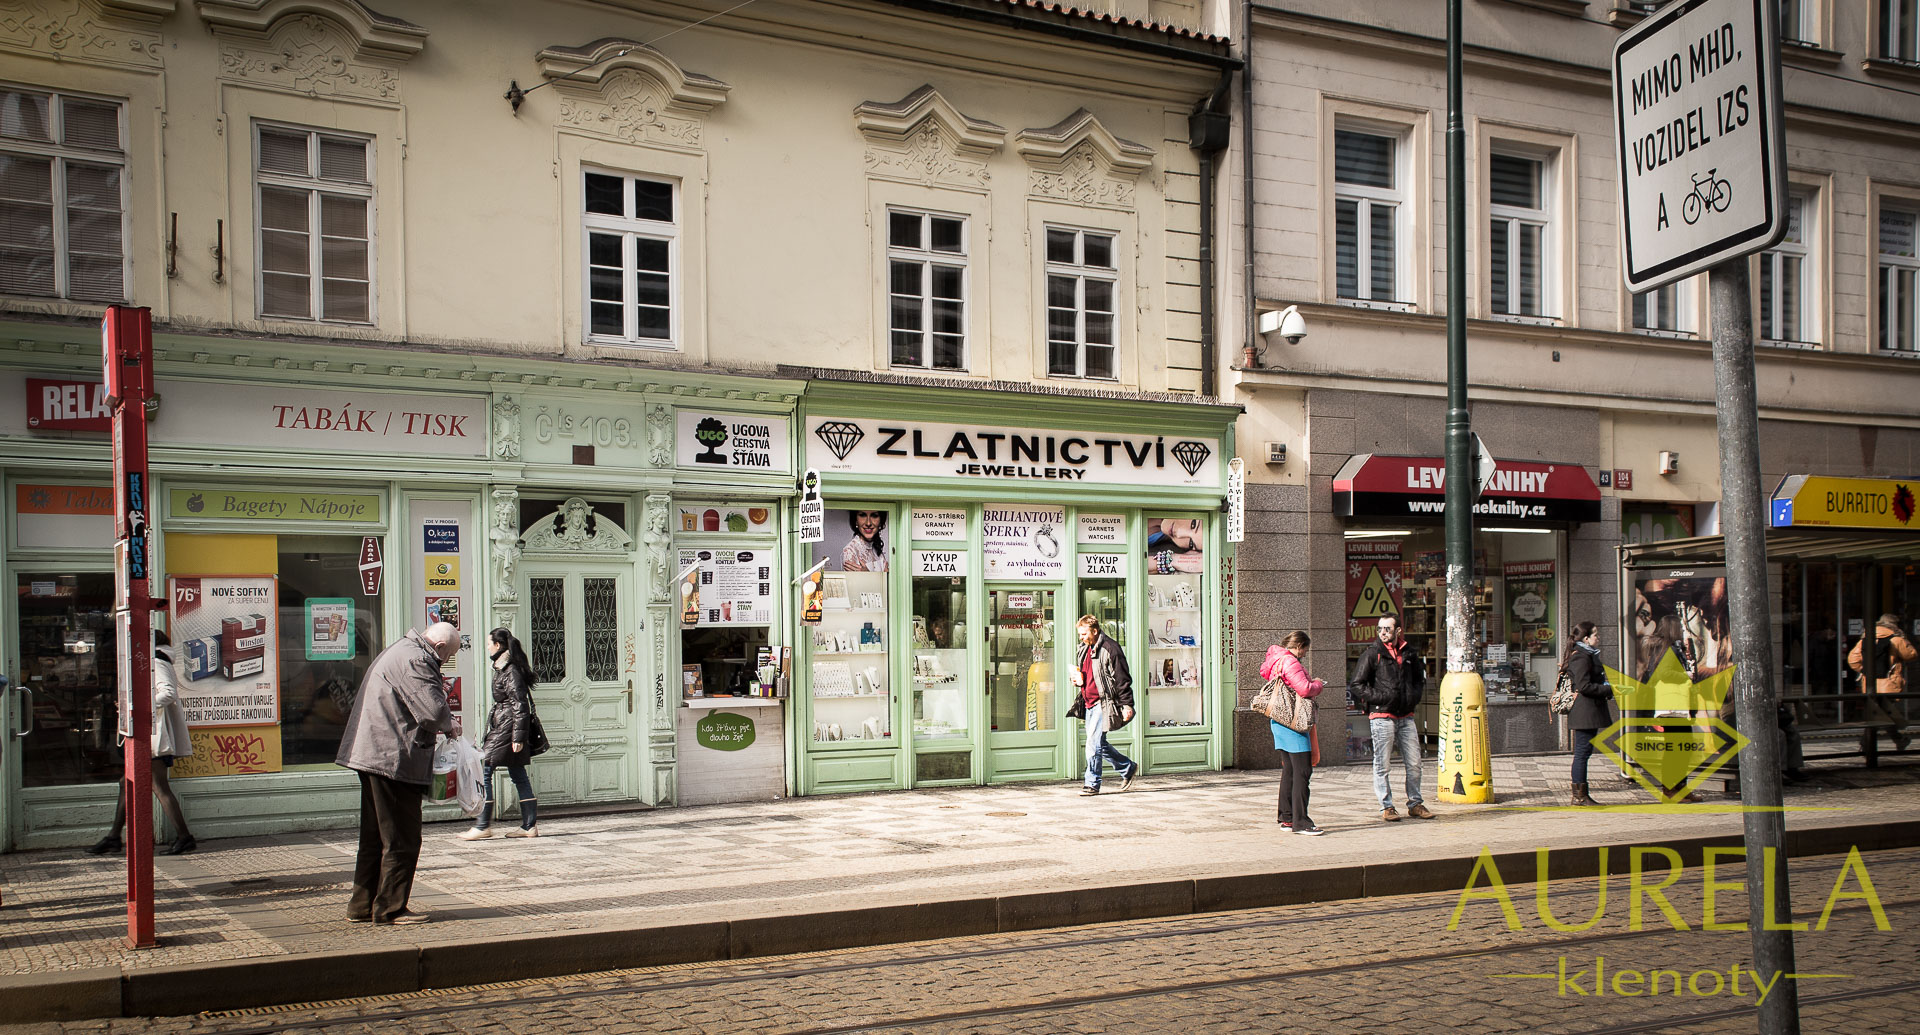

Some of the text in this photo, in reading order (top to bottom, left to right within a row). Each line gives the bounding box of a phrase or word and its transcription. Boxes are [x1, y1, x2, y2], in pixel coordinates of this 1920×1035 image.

[1632, 22, 1742, 116] MIMO MHD,
[1633, 84, 1749, 177] VOZIDEL IZS
[1657, 192, 1669, 232] A
[43, 384, 112, 420] RELA
[273, 403, 469, 437] TABÁK / TISK
[698, 430, 726, 441] UGO
[732, 424, 770, 437] UGOVA
[732, 436, 770, 449] ČERSTVÁ
[876, 428, 1165, 468] ZLATNICTVÍ
[732, 449, 771, 467] ŠŤÁVA
[956, 463, 1086, 480] JEWELLERY
[1408, 466, 1446, 489] LEV
[1618, 472, 1629, 481] 104
[1601, 474, 1609, 483] 43
[62, 489, 114, 509] Tabá
[1826, 491, 1888, 514] BURRITO
[222, 495, 365, 519] Bagety Nápoje
[801, 502, 821, 514] UGOVA
[1408, 500, 1546, 518] wwwneknihy.cz
[938, 511, 965, 520] STŘÍBRO
[984, 510, 1063, 523] BRILIANTOVÉ
[437, 529, 456, 537] karta
[984, 523, 1030, 537] ŠPERKY
[1348, 543, 1399, 552] LEVNÉ KNIHY
[922, 551, 958, 562] VÝKUP
[1086, 554, 1119, 565] VÝKUP
[923, 563, 957, 572] ZLATA
[1047, 561, 1063, 570] ceny
[1087, 565, 1117, 574] ZLATA
[1506, 563, 1552, 573] LEVNÉ KNIHY
[1024, 568, 1047, 577] od nás
[176, 587, 195, 602] 76
[211, 585, 269, 597] NOVÉ SOFTKY
[1351, 624, 1377, 641] výpr
[240, 638, 264, 648] Winston
[209, 645, 217, 668] Winston
[181, 696, 213, 708] NISTERSTVO
[213, 694, 253, 707] ZDRAVOTNICTVÍ
[184, 708, 274, 721] UŘENÍ ZPŮSOBUJE RAKOVINU.
[701, 724, 714, 732] kdo
[1453, 692, 1463, 762] eat fresh.
[709, 732, 730, 742] dlouho
